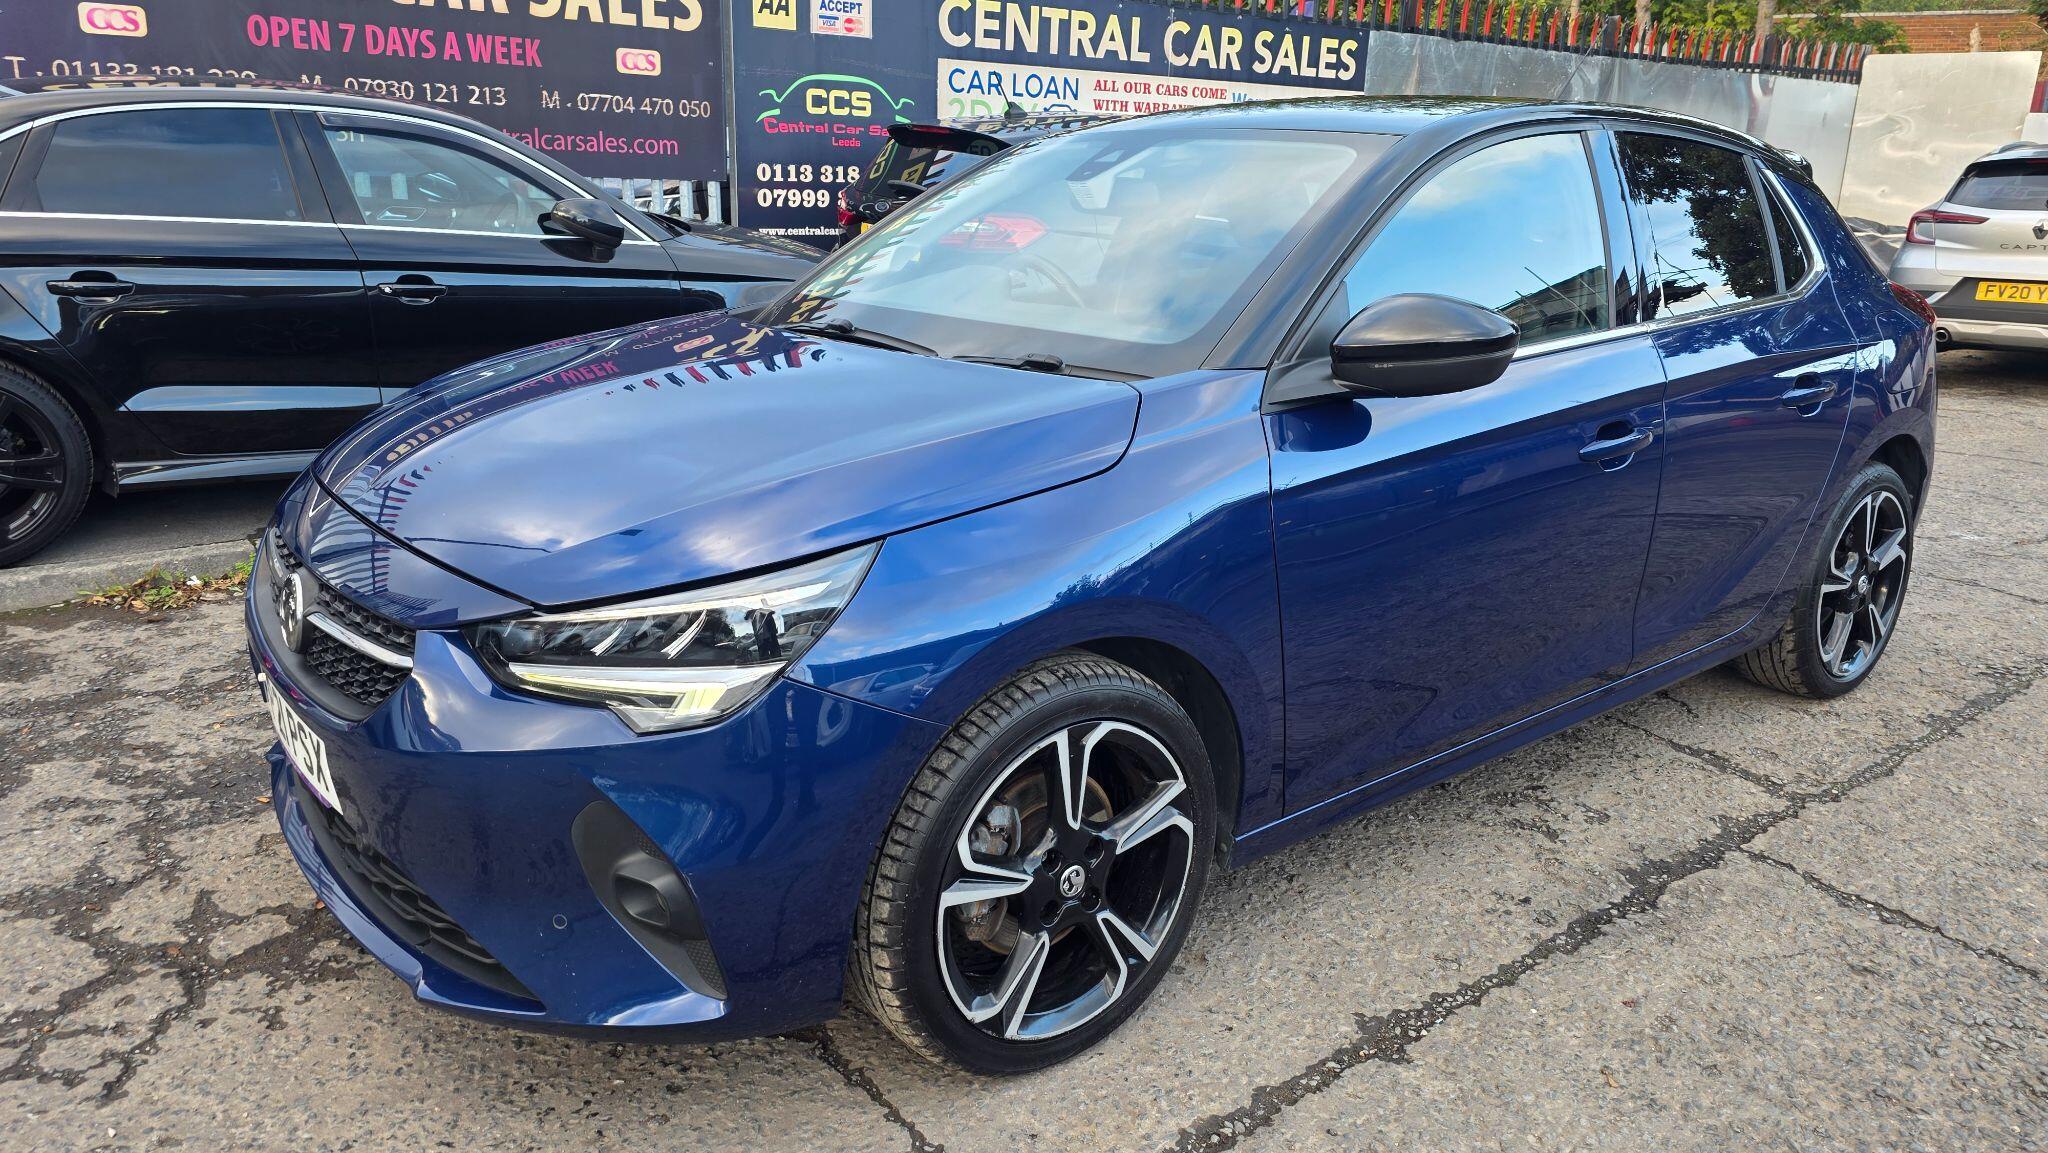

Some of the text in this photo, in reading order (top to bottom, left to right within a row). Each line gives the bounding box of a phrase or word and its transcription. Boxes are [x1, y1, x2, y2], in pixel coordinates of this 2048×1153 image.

[758, 0, 789, 16] AA
[819, 0, 862, 14] ACCEPT
[86, 7, 140, 32] CCS
[822, 19, 836, 27] VISA
[247, 14, 543, 68] OPEN 7 DAYS A WEEK
[938, 0, 1359, 81] CENTRAL CAR SALES
[621, 51, 657, 72] CCS
[422, 82, 459, 103] 121
[467, 85, 508, 106] 213
[948, 67, 1079, 101] CAR LOAN
[1093, 79, 1228, 100] ALL OUR CARS COME
[577, 93, 635, 114] 07704
[640, 97, 674, 116] 470
[679, 99, 711, 118] 050
[805, 87, 871, 118] CCS
[948, 97, 1039, 119] 2DY
[1093, 99, 1197, 114] WITH WARR
[763, 117, 829, 134] Central
[833, 123, 864, 135] Car
[831, 136, 861, 147] Leeds
[756, 162, 860, 183] 0113 318
[757, 188, 830, 208] 07999
[1984, 284, 2031, 300] FV20
